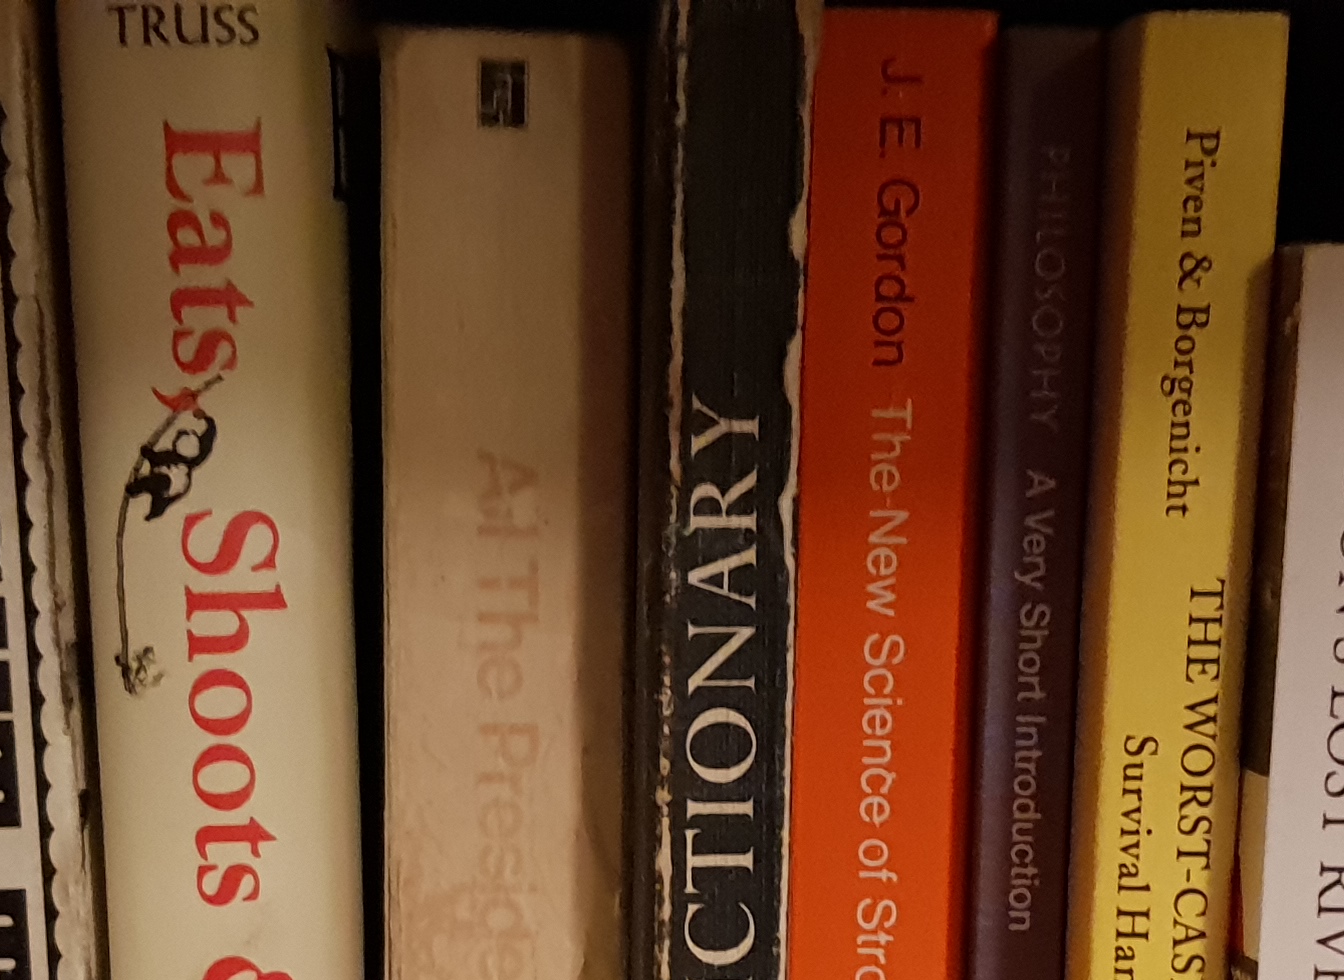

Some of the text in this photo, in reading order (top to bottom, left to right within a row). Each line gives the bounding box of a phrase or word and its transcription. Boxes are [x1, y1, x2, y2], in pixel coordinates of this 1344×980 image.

[105, 4, 262, 49] TRUSS
[878, 56, 924, 95] J.
[875, 113, 924, 160] E.
[152, 119, 267, 413] Eats,
[869, 176, 924, 369] Gordon
[1160, 127, 1223, 521] Piven & Borgenicht
[867, 398, 916, 490] The
[863, 508, 911, 616] New
[1006, 142, 1076, 933] PHILOSOPHY A Very Short Introduction
[475, 557, 540, 702] The
[1182, 577, 1228, 683] THE
[178, 508, 288, 909] Shoots
[855, 630, 908, 825] Science
[855, 837, 904, 884] of
[1111, 734, 1160, 894] Survival
